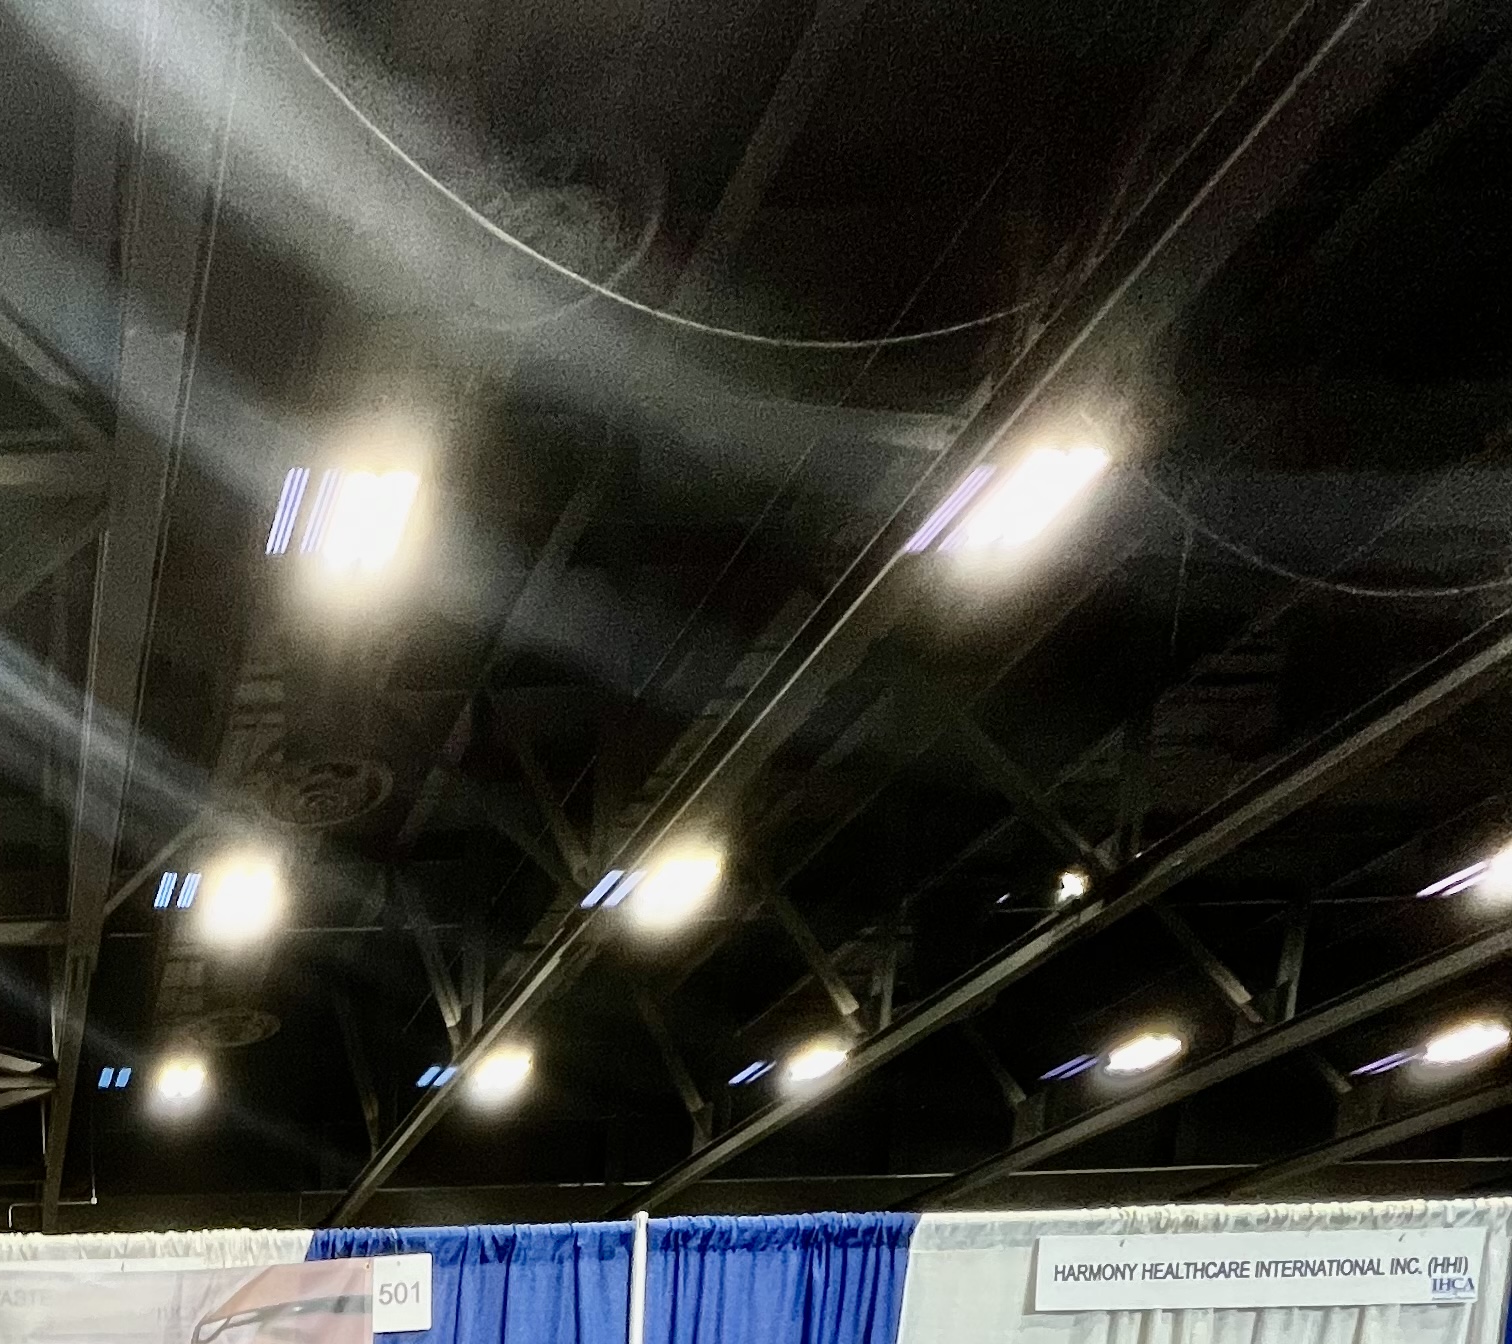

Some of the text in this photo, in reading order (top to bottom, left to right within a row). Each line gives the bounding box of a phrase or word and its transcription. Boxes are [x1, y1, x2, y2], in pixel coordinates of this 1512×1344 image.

[1054, 1256, 1468, 1281] HARMONY HEALTHCARE INTERNATIONAL INC. (HHI)
[379, 1281, 419, 1305] 501
[1432, 1277, 1475, 1292] IHCA
